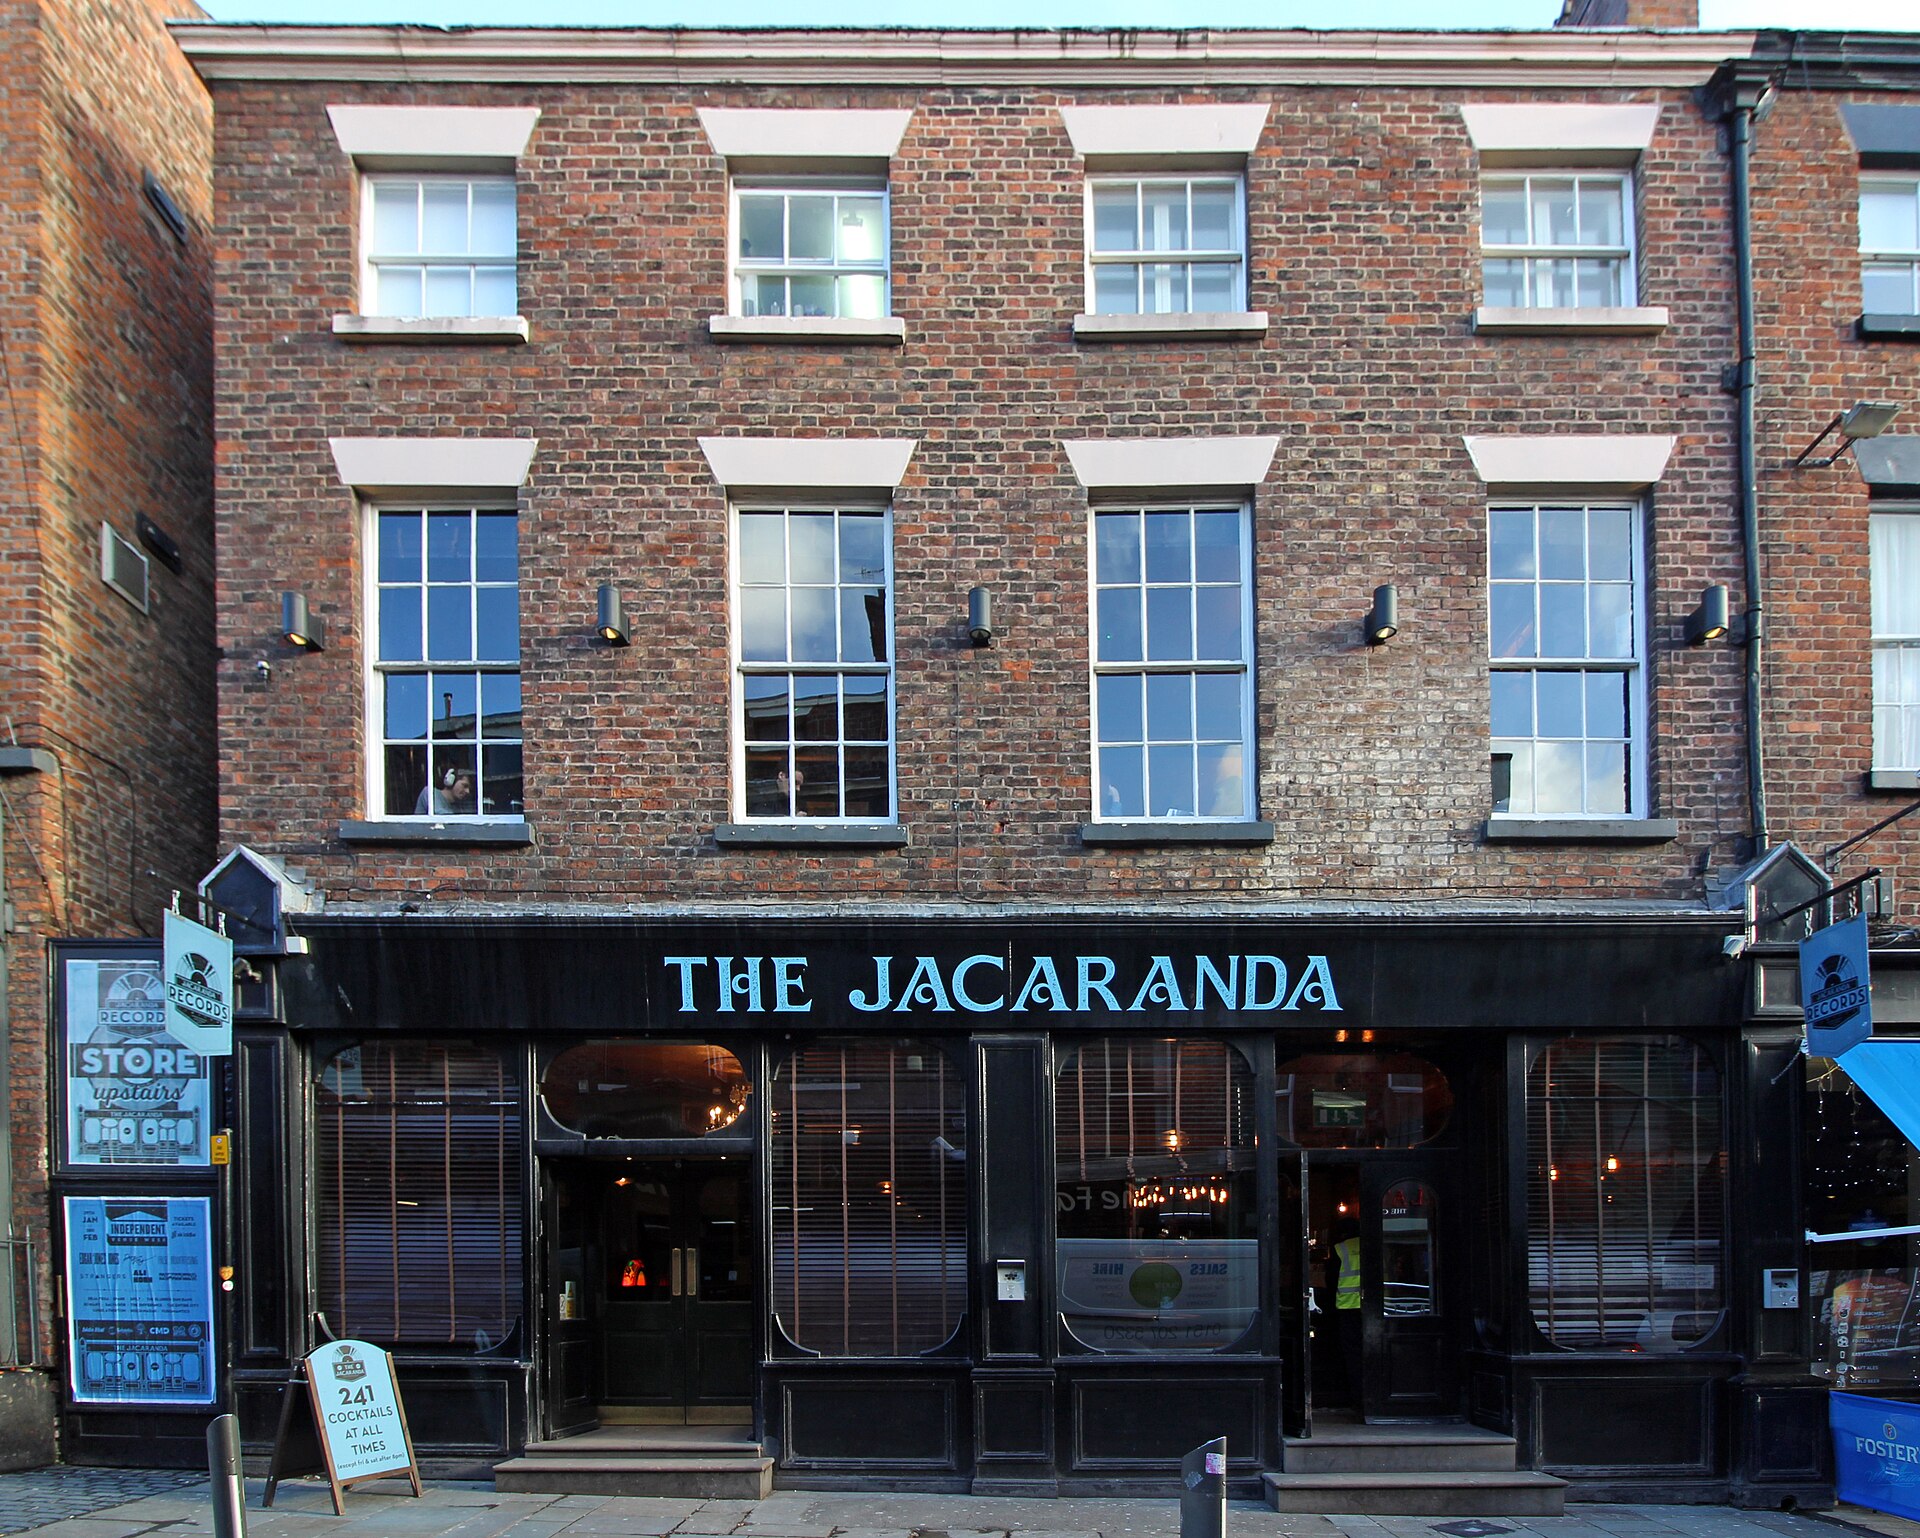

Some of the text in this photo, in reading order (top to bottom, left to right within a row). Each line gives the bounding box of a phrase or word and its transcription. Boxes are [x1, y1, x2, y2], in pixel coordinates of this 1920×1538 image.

[664, 954, 1344, 1013] THE JACARANDA
[169, 985, 228, 1020] RECORDS
[1807, 989, 1866, 1020] RECORDS
[100, 1011, 165, 1023] RECORD
[81, 1047, 198, 1075] STORE
[93, 1085, 186, 1108] upstairs
[82, 1216, 98, 1224] JAN
[111, 1223, 166, 1235] INDEPENDENT
[83, 1233, 98, 1241] FEB
[149, 1327, 170, 1335] CMD
[338, 1384, 375, 1406] 241
[328, 1405, 393, 1424] COCKTAILS
[345, 1424, 383, 1440] AT ALL
[351, 1440, 386, 1456] TIMES
[1855, 1436, 1920, 1464] FOSTER'
